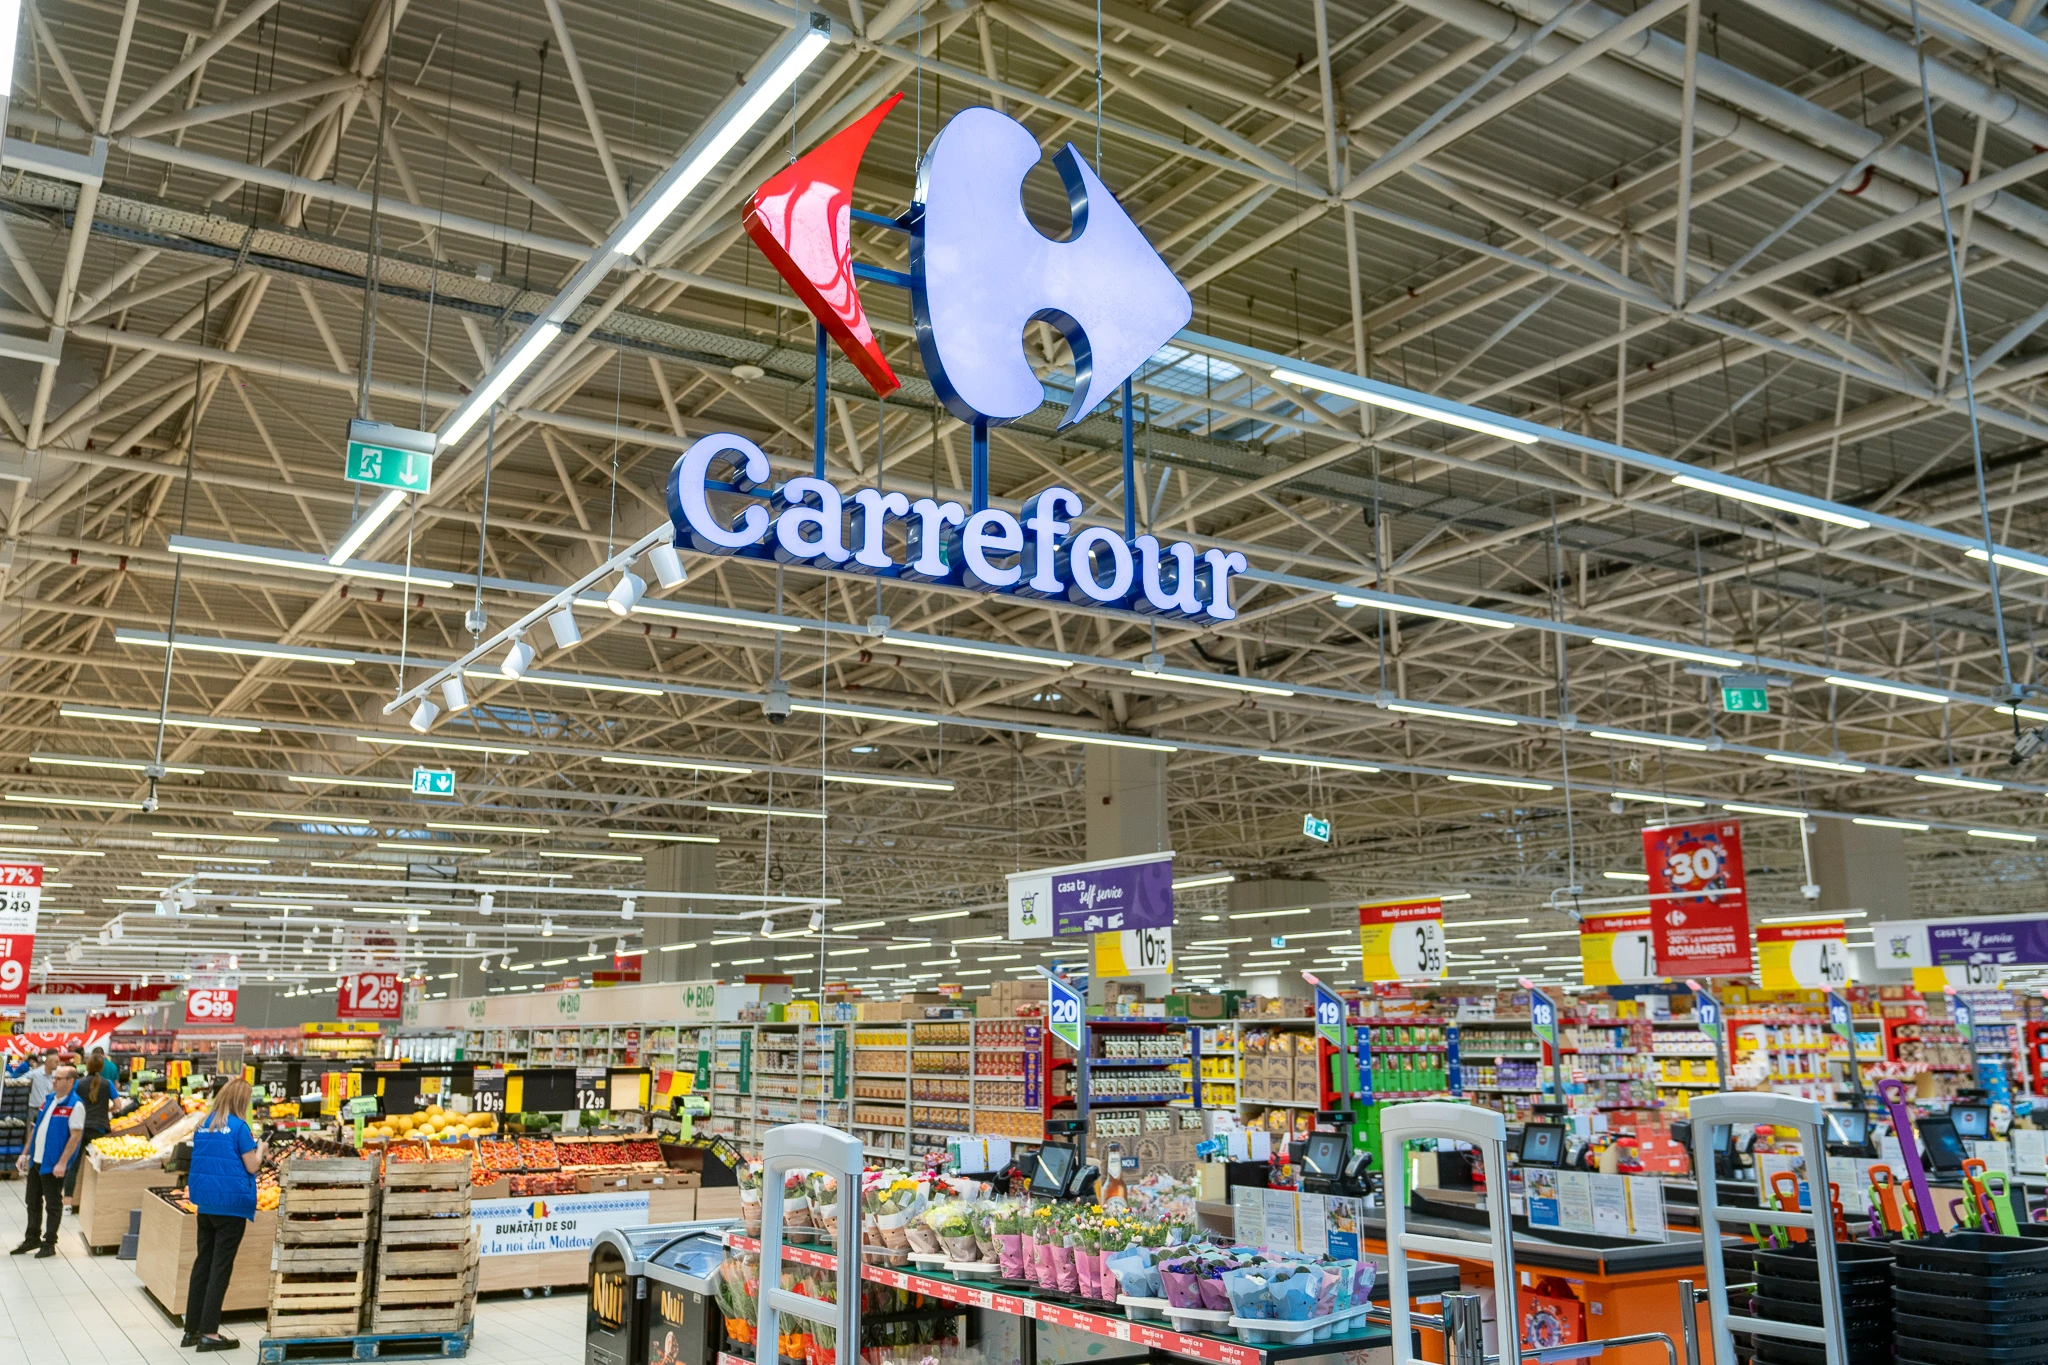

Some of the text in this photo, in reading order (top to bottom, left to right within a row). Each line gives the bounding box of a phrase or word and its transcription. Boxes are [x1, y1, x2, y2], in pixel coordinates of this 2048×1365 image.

[675, 431, 1249, 622] Carrefour
[0, 867, 35, 884] 7%
[1057, 879, 1086, 893] casa ta
[10, 901, 31, 912] 49
[1079, 884, 1123, 909] self service
[1135, 928, 1167, 967] 16 75
[1416, 927, 1428, 972] 3
[1428, 948, 1440, 971] 55
[1637, 935, 1648, 976] 7
[1820, 944, 1830, 981] 4
[0, 959, 23, 991] 9
[343, 974, 399, 1009] 12 LEI 99
[696, 985, 715, 1008] BIO
[189, 990, 234, 1017] 6 LEI 99
[567, 993, 581, 1013] BIO
[1052, 999, 1078, 1023] 20
[1318, 1002, 1339, 1024] 19
[1533, 1004, 1552, 1025] 18
[1700, 1005, 1715, 1024] 17
[269, 1081, 278, 1097] 9
[474, 1091, 504, 1112] 19 99
[576, 1090, 605, 1110] 12 99
[1121, 1159, 1135, 1167] NOU
[496, 1220, 577, 1238] BUNĂTĂȚI DE SOI
[491, 1240, 502, 1253] la
[506, 1237, 523, 1251] noi
[527, 1236, 546, 1251] din
[550, 1235, 593, 1249] Moldova
[593, 1272, 623, 1325] Nuii
[661, 1290, 684, 1326] Nuii
[1143, 1338, 1162, 1348] mai bun
[1181, 1346, 1201, 1356] mai bun
[1221, 1355, 1242, 1365] mai bun
